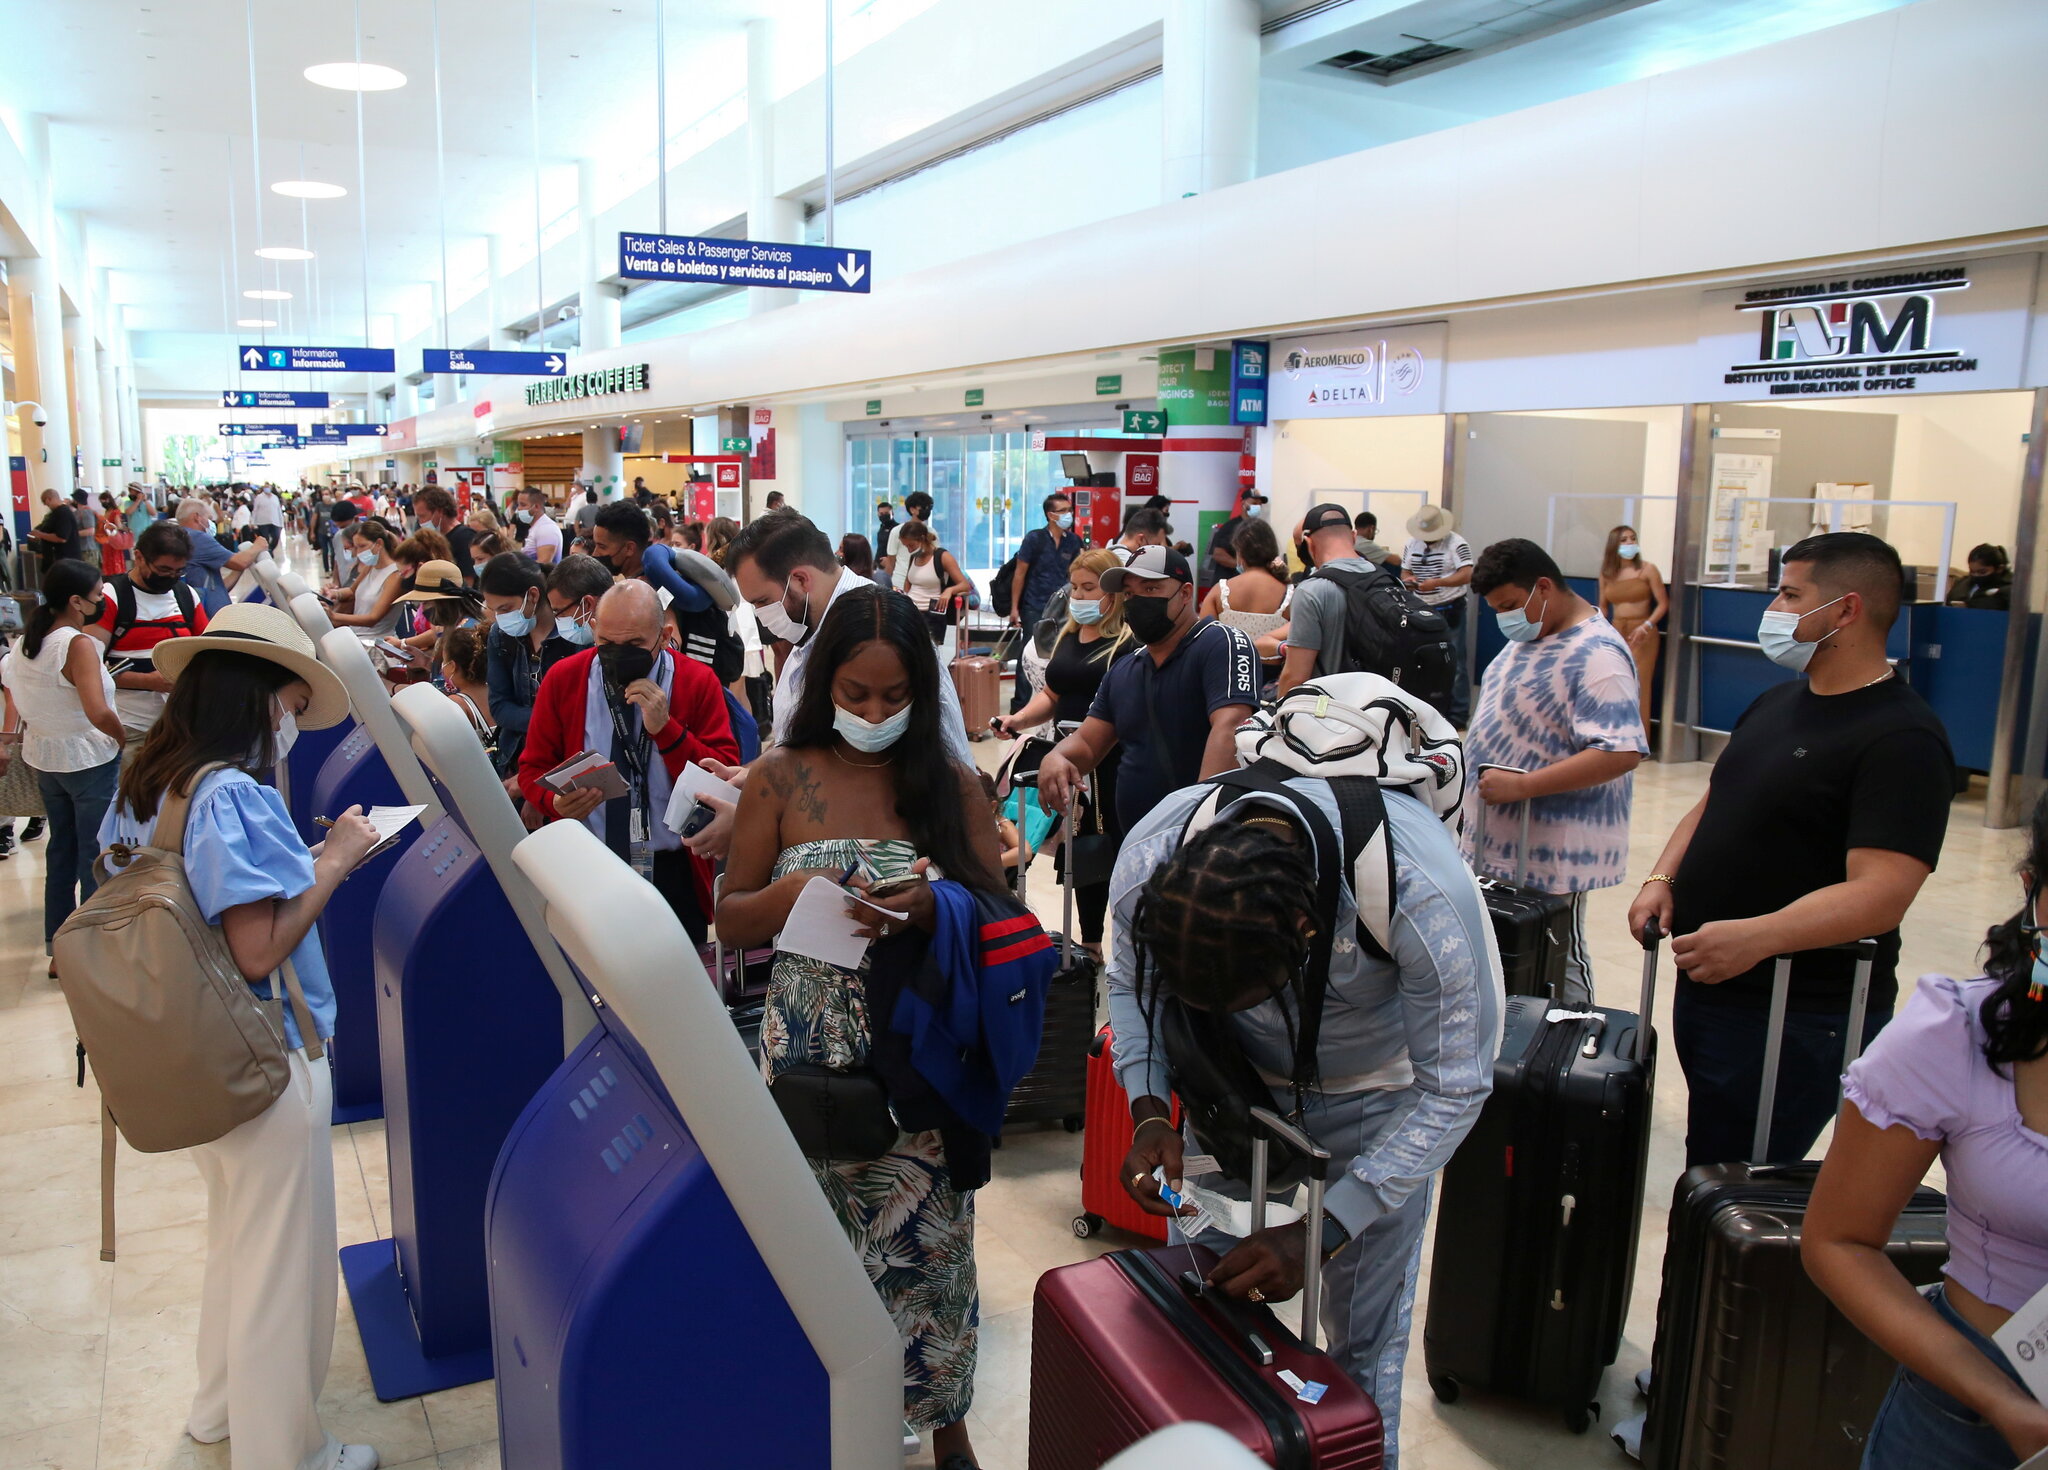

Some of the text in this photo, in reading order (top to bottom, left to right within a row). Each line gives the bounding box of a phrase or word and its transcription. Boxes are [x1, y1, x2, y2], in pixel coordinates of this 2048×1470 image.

[624, 236, 792, 263] Ticket Sales & Passenger Services
[624, 255, 833, 285] Venta de boletos y servicios al pasajero
[1744, 266, 1966, 302] SECRETARIA DE GOBERNACION
[292, 348, 338, 358] Information
[449, 351, 464, 361] Exit
[292, 358, 346, 369] Información
[449, 360, 475, 371] Salida
[1303, 353, 1365, 368] AEROMEXICO
[1724, 358, 1978, 384] INSTITUTO NACIONAL DE MIGRACION
[525, 362, 644, 406] STARBUCKS COFFEE
[1769, 376, 1917, 395] IMMIGRATION OFFICE
[258, 391, 290, 399] Information
[1322, 387, 1367, 401] DELTA
[1240, 398, 1262, 412] ATM
[1032, 439, 1045, 449] BAG
[1134, 472, 1152, 482] BAG
[1237, 654, 1251, 692] KORS
